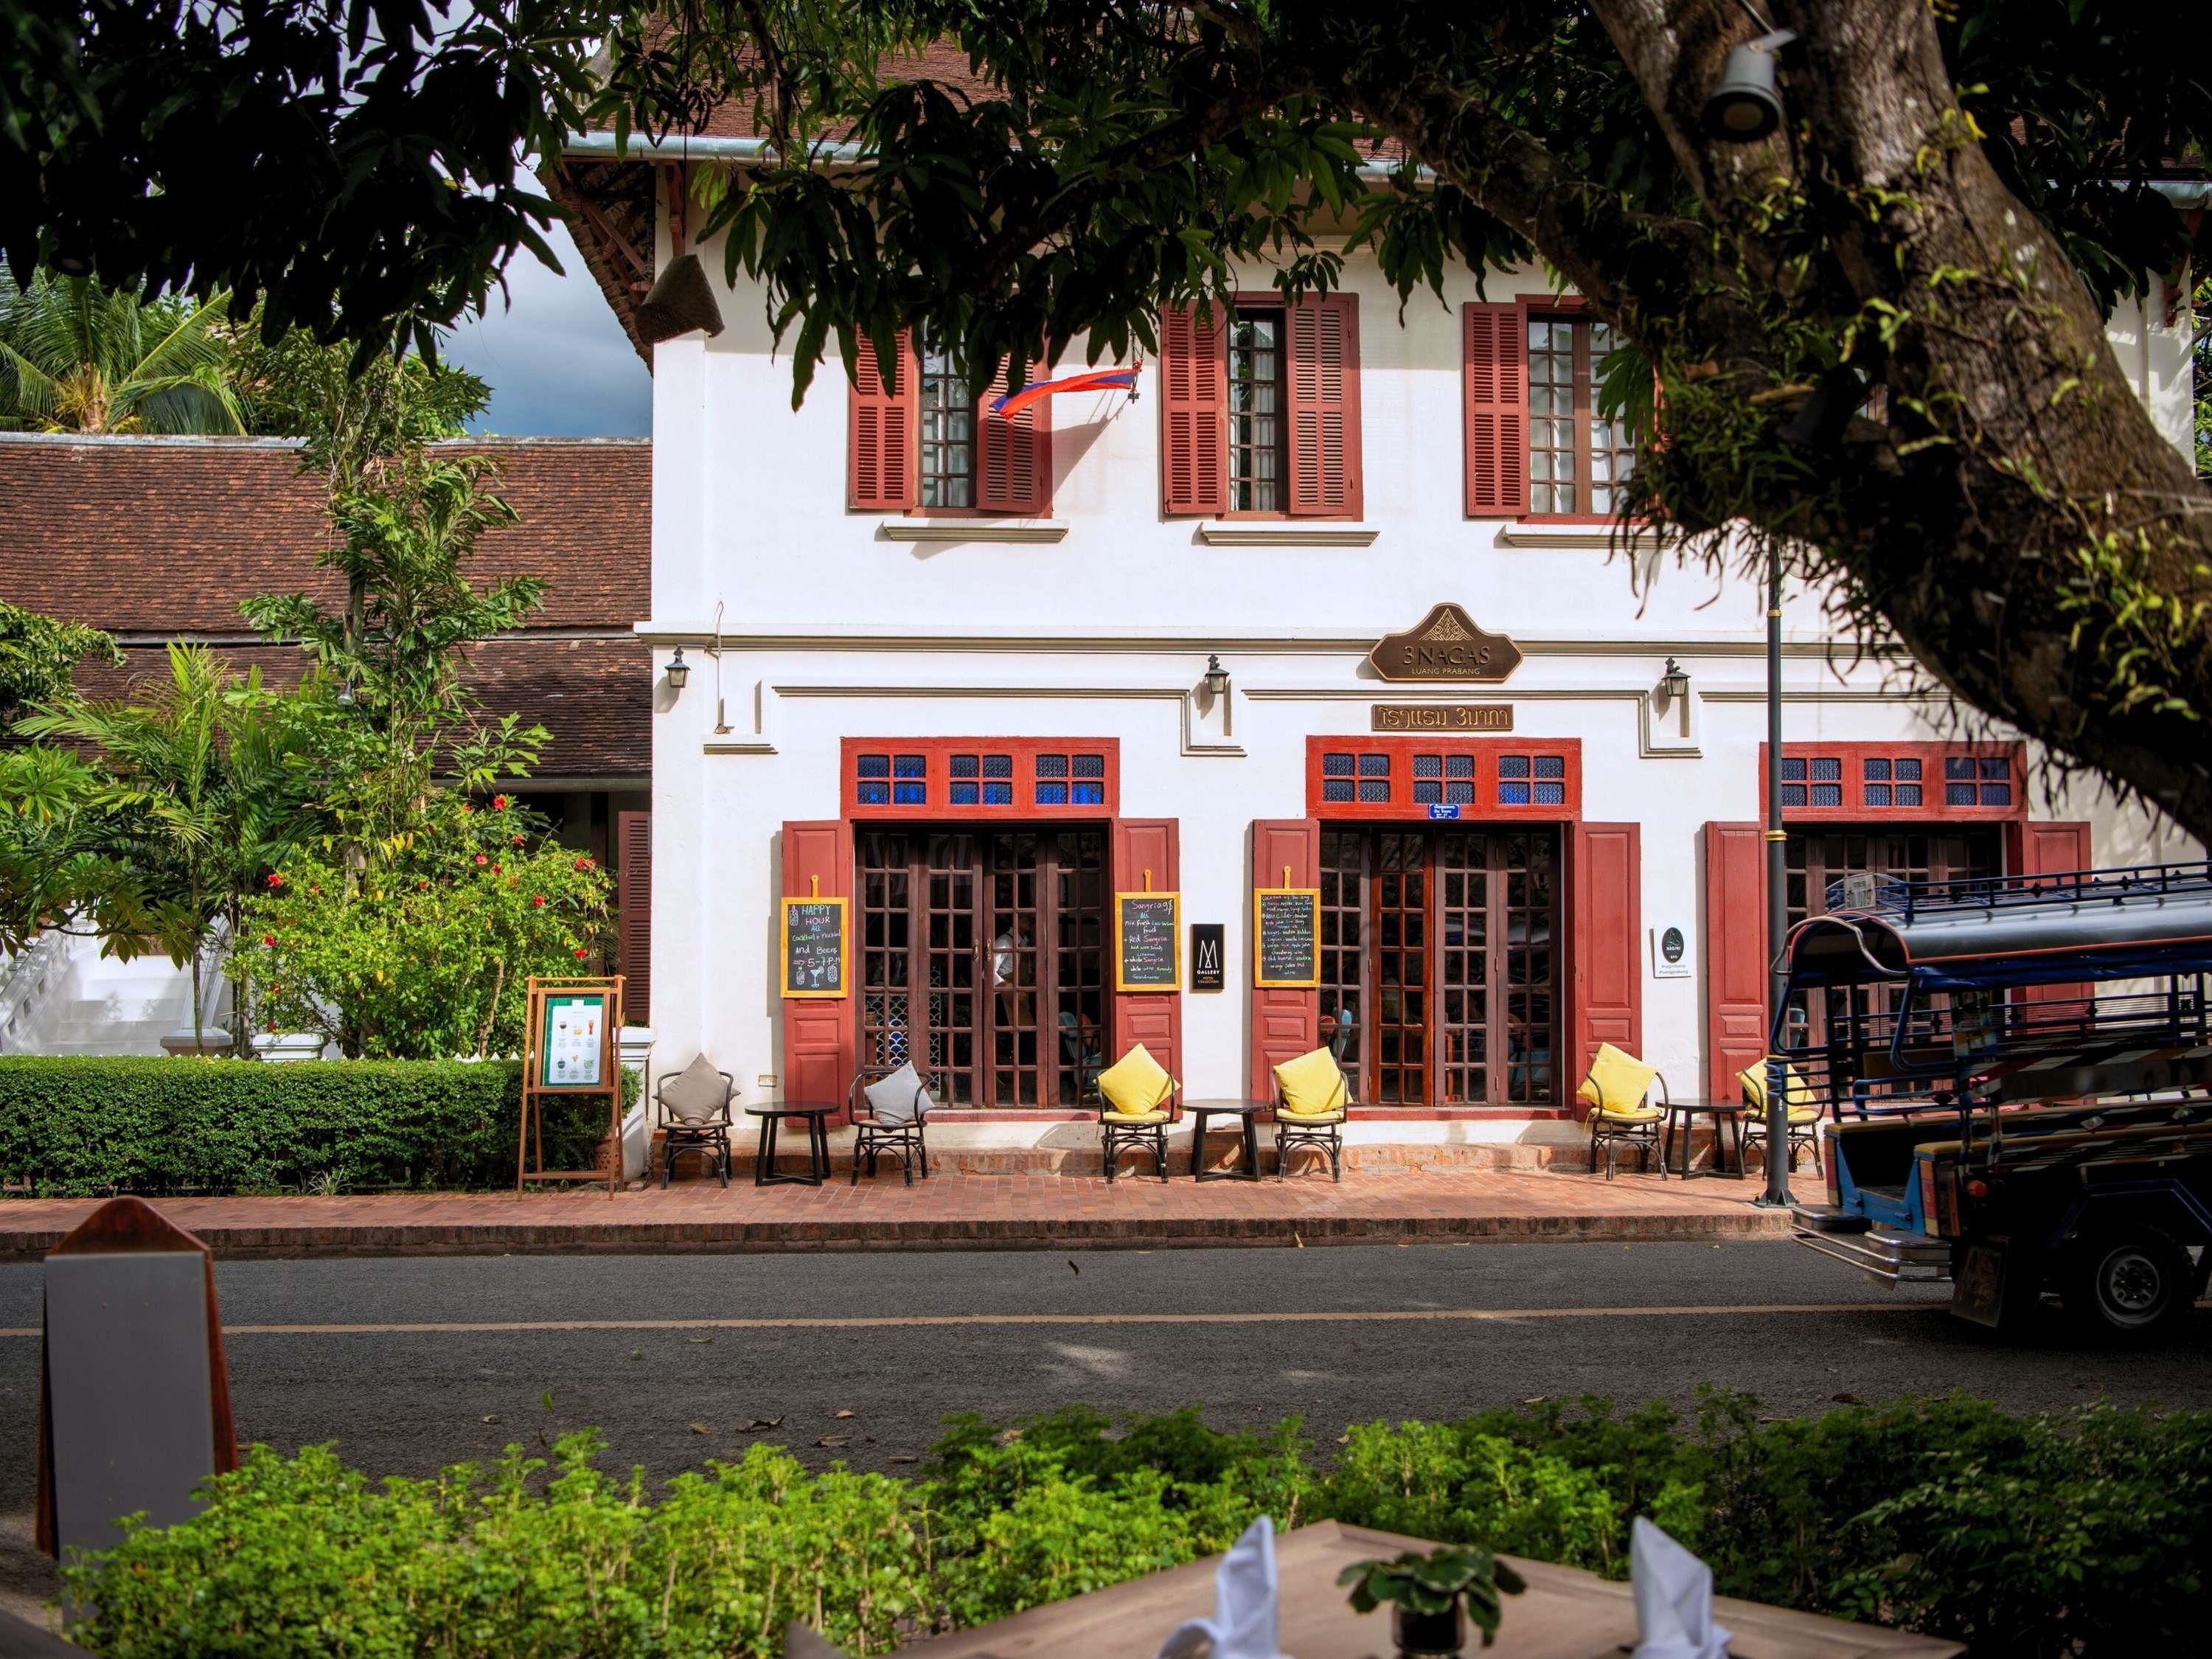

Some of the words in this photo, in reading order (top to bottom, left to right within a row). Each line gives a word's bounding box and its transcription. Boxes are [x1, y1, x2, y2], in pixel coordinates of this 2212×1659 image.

[1403, 646, 1413, 664] 3
[1418, 646, 1490, 665] NAGAS
[801, 905, 832, 916] HAPPY
[1132, 900, 1162, 913] Sangria
[805, 916, 831, 925] HOUR
